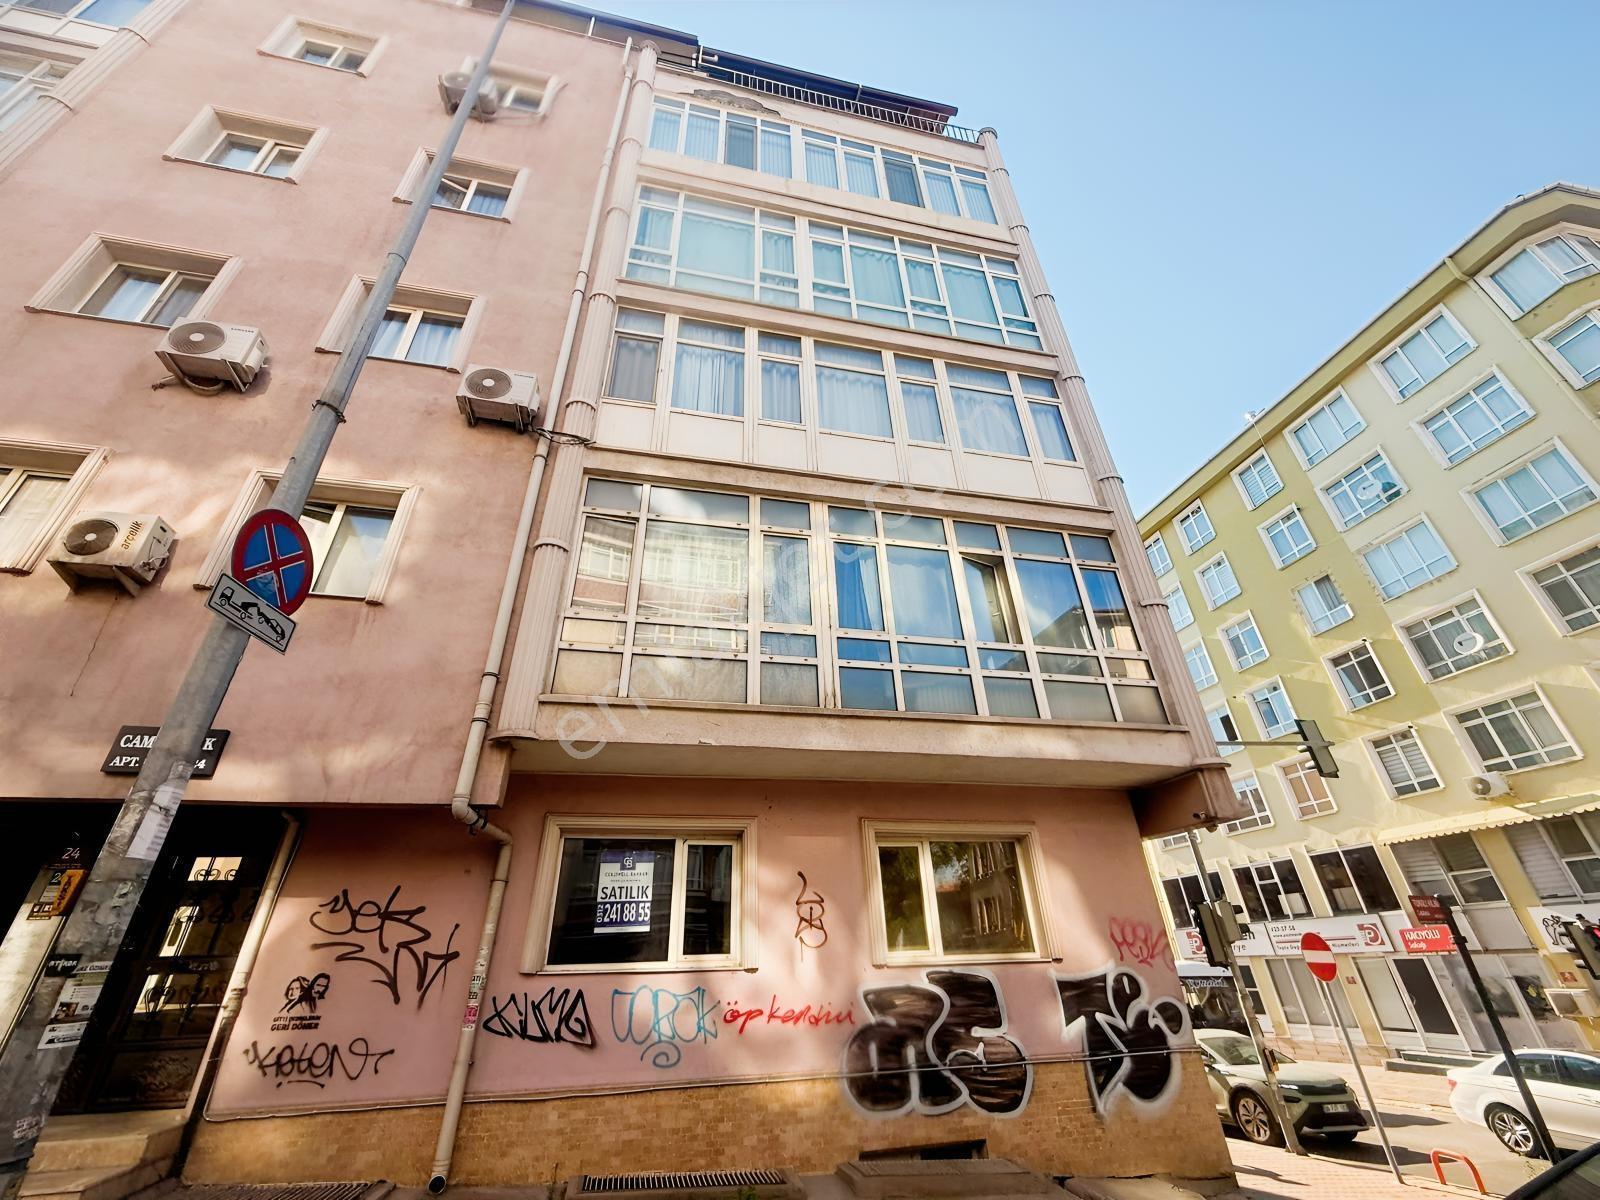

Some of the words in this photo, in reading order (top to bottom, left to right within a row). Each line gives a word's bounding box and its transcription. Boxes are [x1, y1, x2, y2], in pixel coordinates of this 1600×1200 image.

[109, 756, 140, 767] APT.
[600, 885, 649, 900] SATILIK
[604, 903, 621, 923] 241
[623, 903, 636, 922] 88
[638, 902, 651, 921] 55
